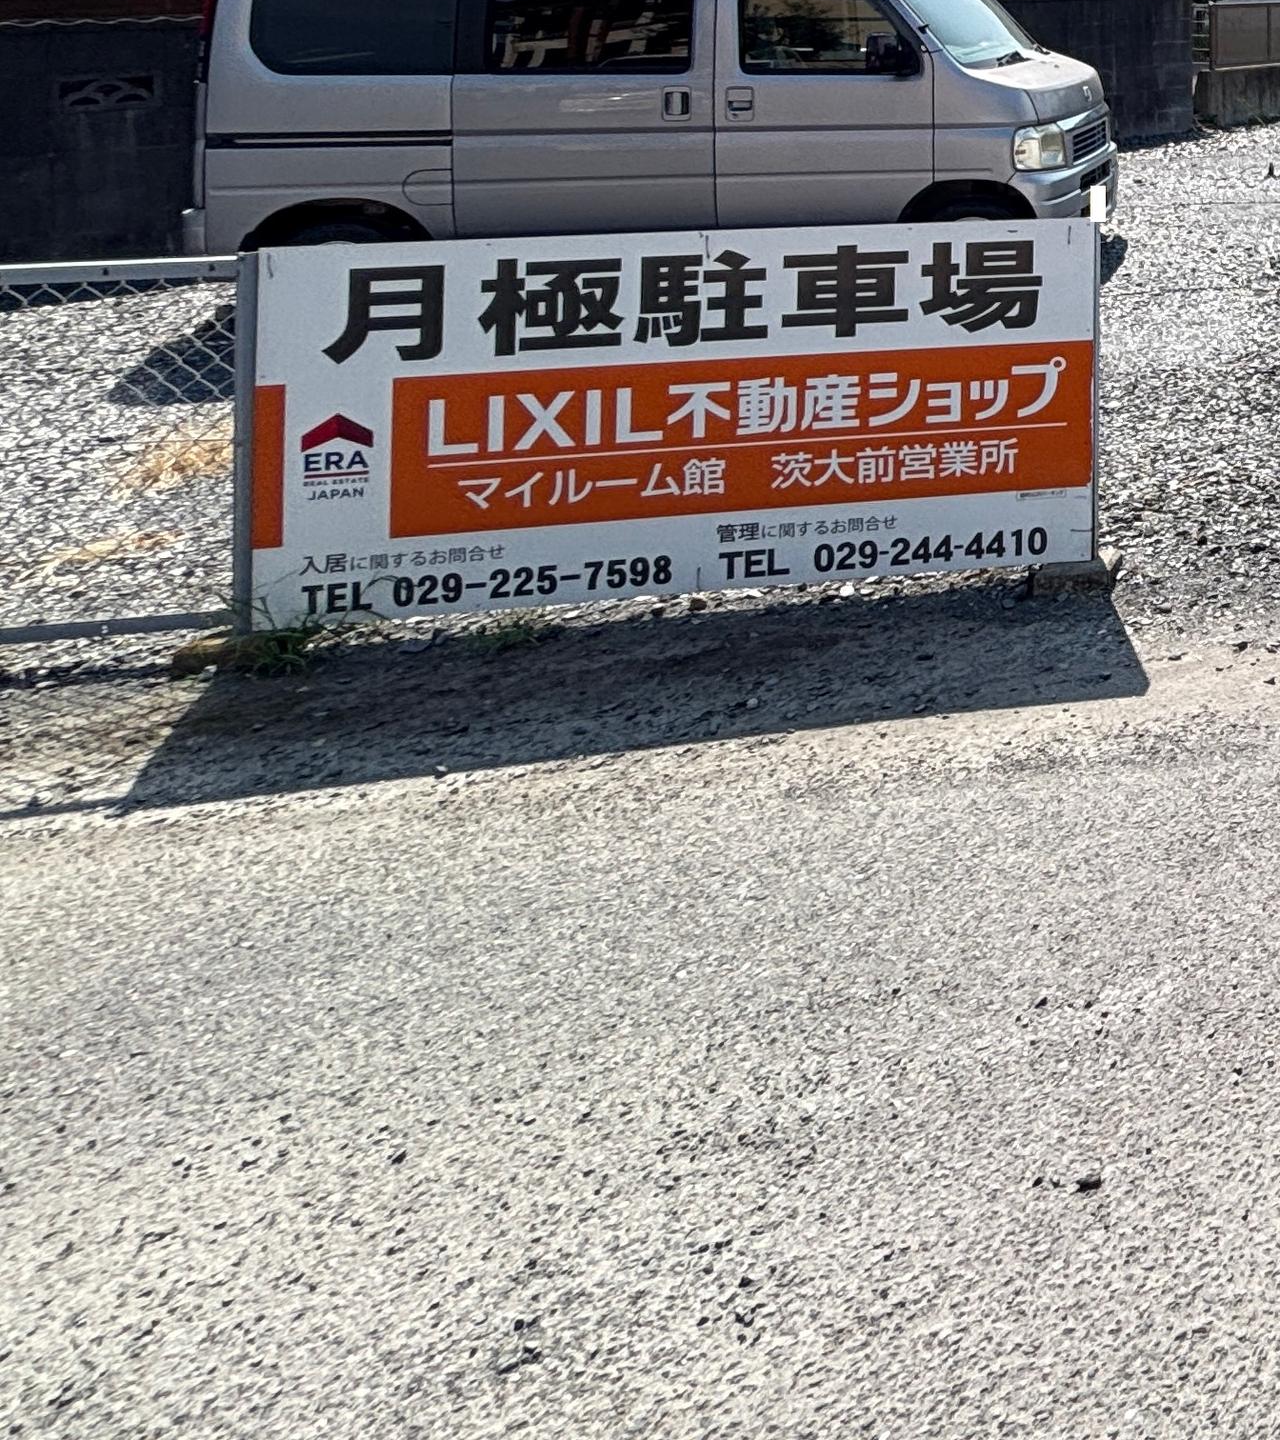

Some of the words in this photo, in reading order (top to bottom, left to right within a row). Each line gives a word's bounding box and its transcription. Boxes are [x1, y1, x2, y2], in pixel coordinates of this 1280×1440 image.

[322, 240, 1043, 365] 月極駐車場
[427, 356, 1067, 456] LIXIL不動産ショップ
[304, 450, 369, 472] ERA
[458, 458, 726, 509] マイルーム館
[771, 437, 1018, 489] 茨大前営業所
[307, 488, 364, 501] JAPAN
[716, 514, 898, 543] 管理に関するお問合せ
[719, 548, 790, 580] TEL
[813, 526, 1048, 572] 029-244-4410
[299, 544, 507, 576] 入居に関するお問合せ
[302, 581, 373, 615] TEL
[393, 555, 673, 608] 029-225-7598
